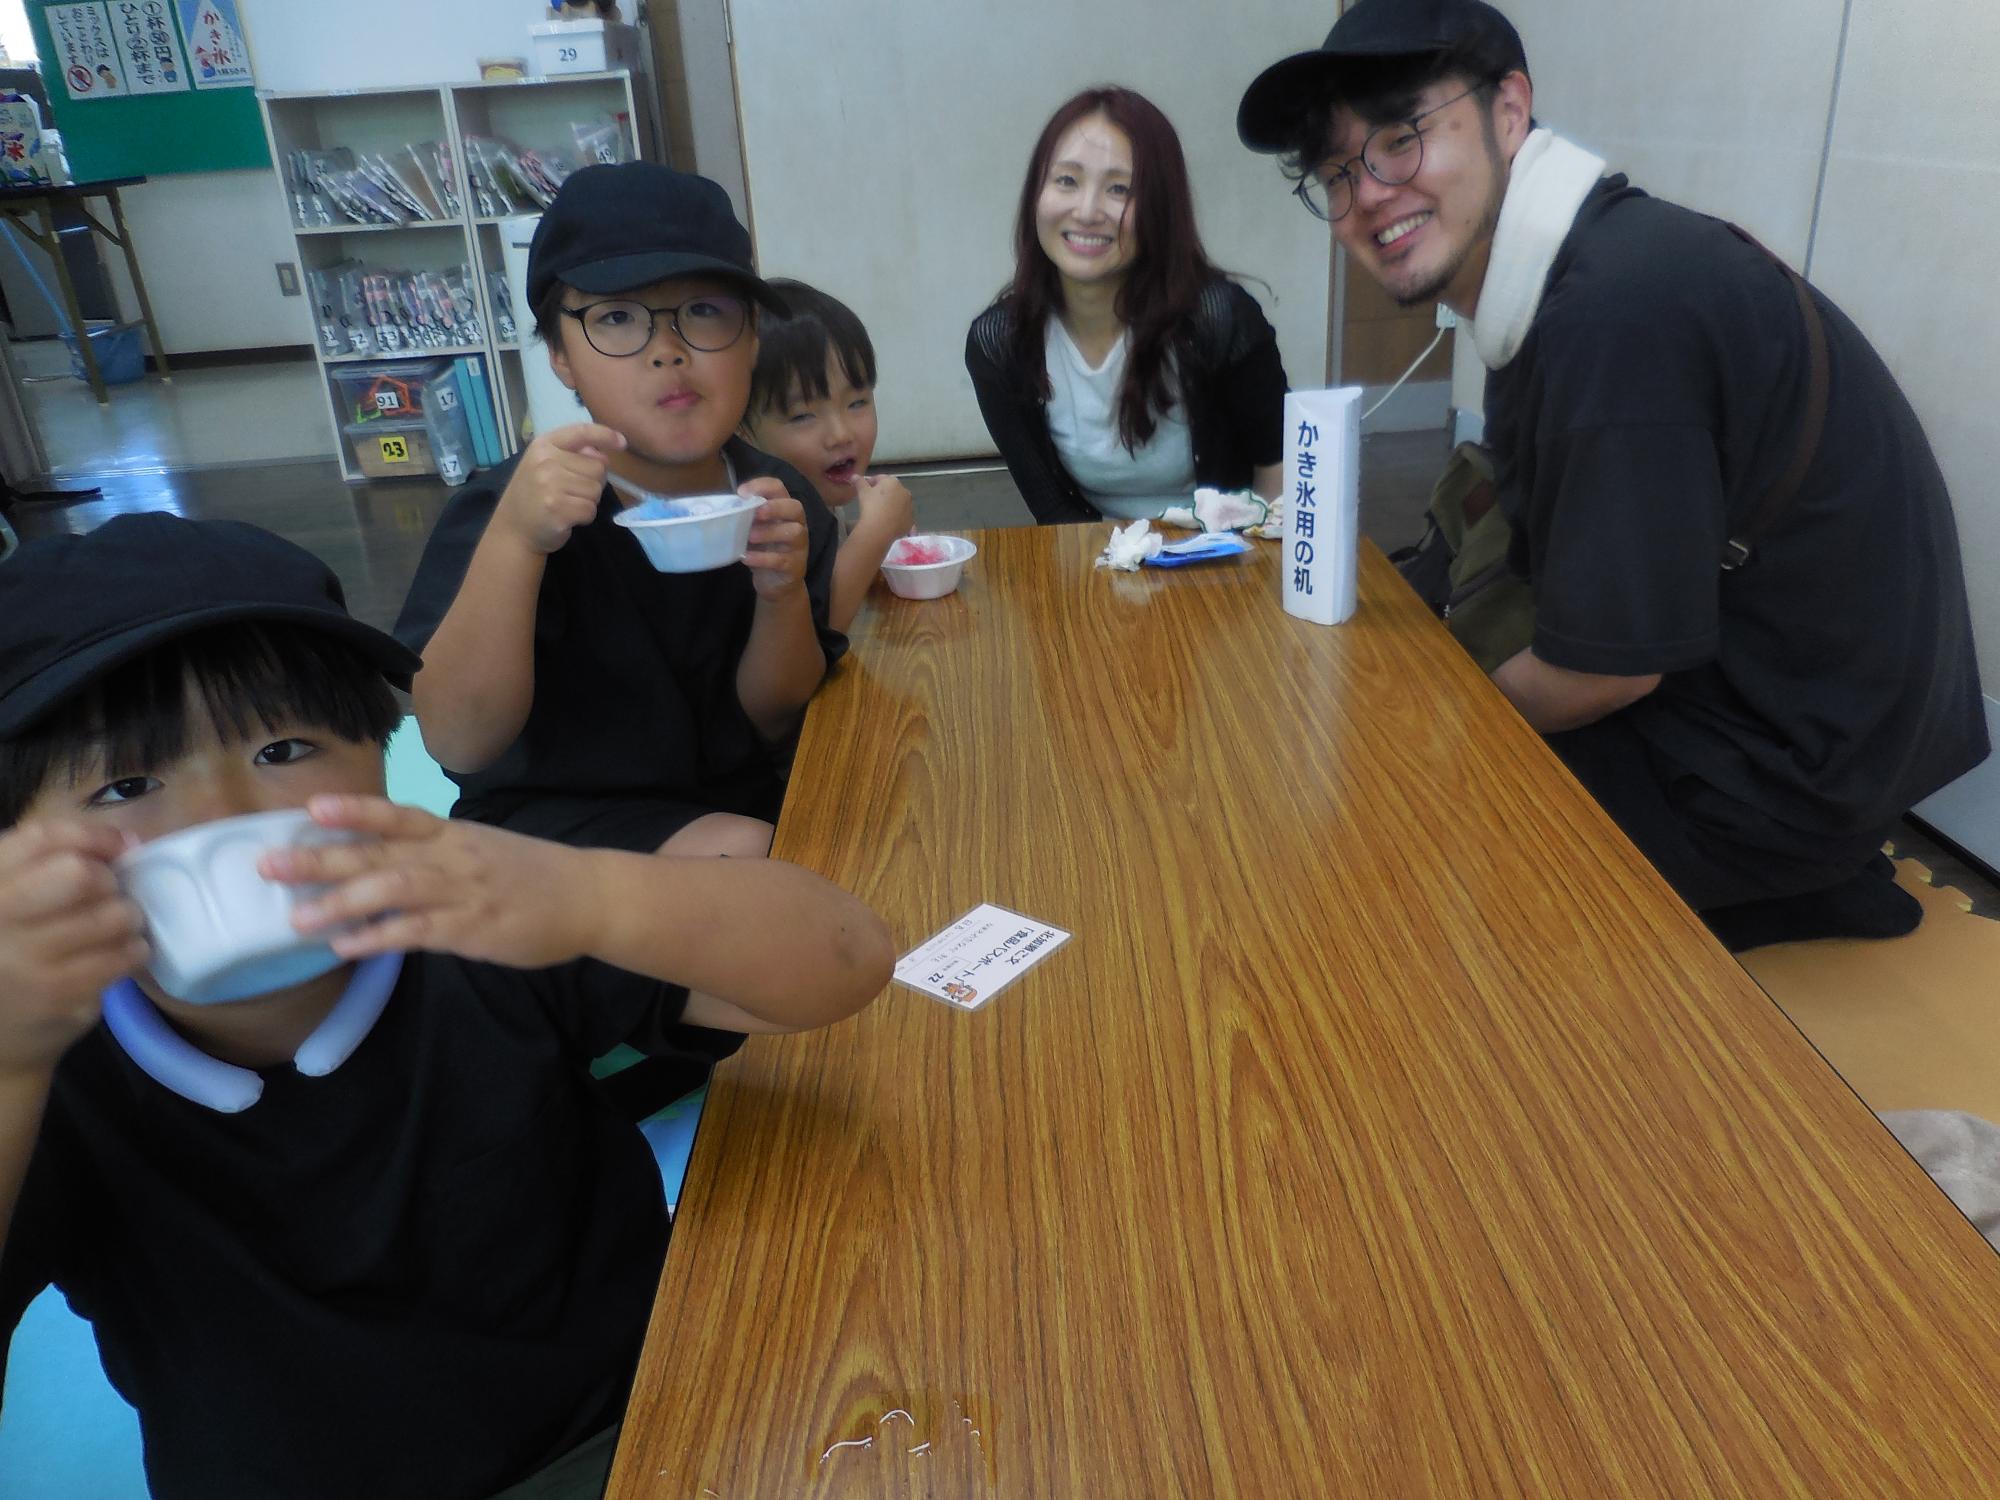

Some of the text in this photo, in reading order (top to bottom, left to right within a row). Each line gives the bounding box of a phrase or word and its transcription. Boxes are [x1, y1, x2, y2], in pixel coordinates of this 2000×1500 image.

[203, 11, 232, 65] かき氷
[558, 47, 578, 62] 29
[376, 396, 396, 408] 91
[440, 392, 455, 407] 17
[383, 441, 405, 458] 23
[443, 460, 458, 473] 17
[1292, 420, 1320, 595] かき氷用の机
[928, 971, 944, 983] 22
